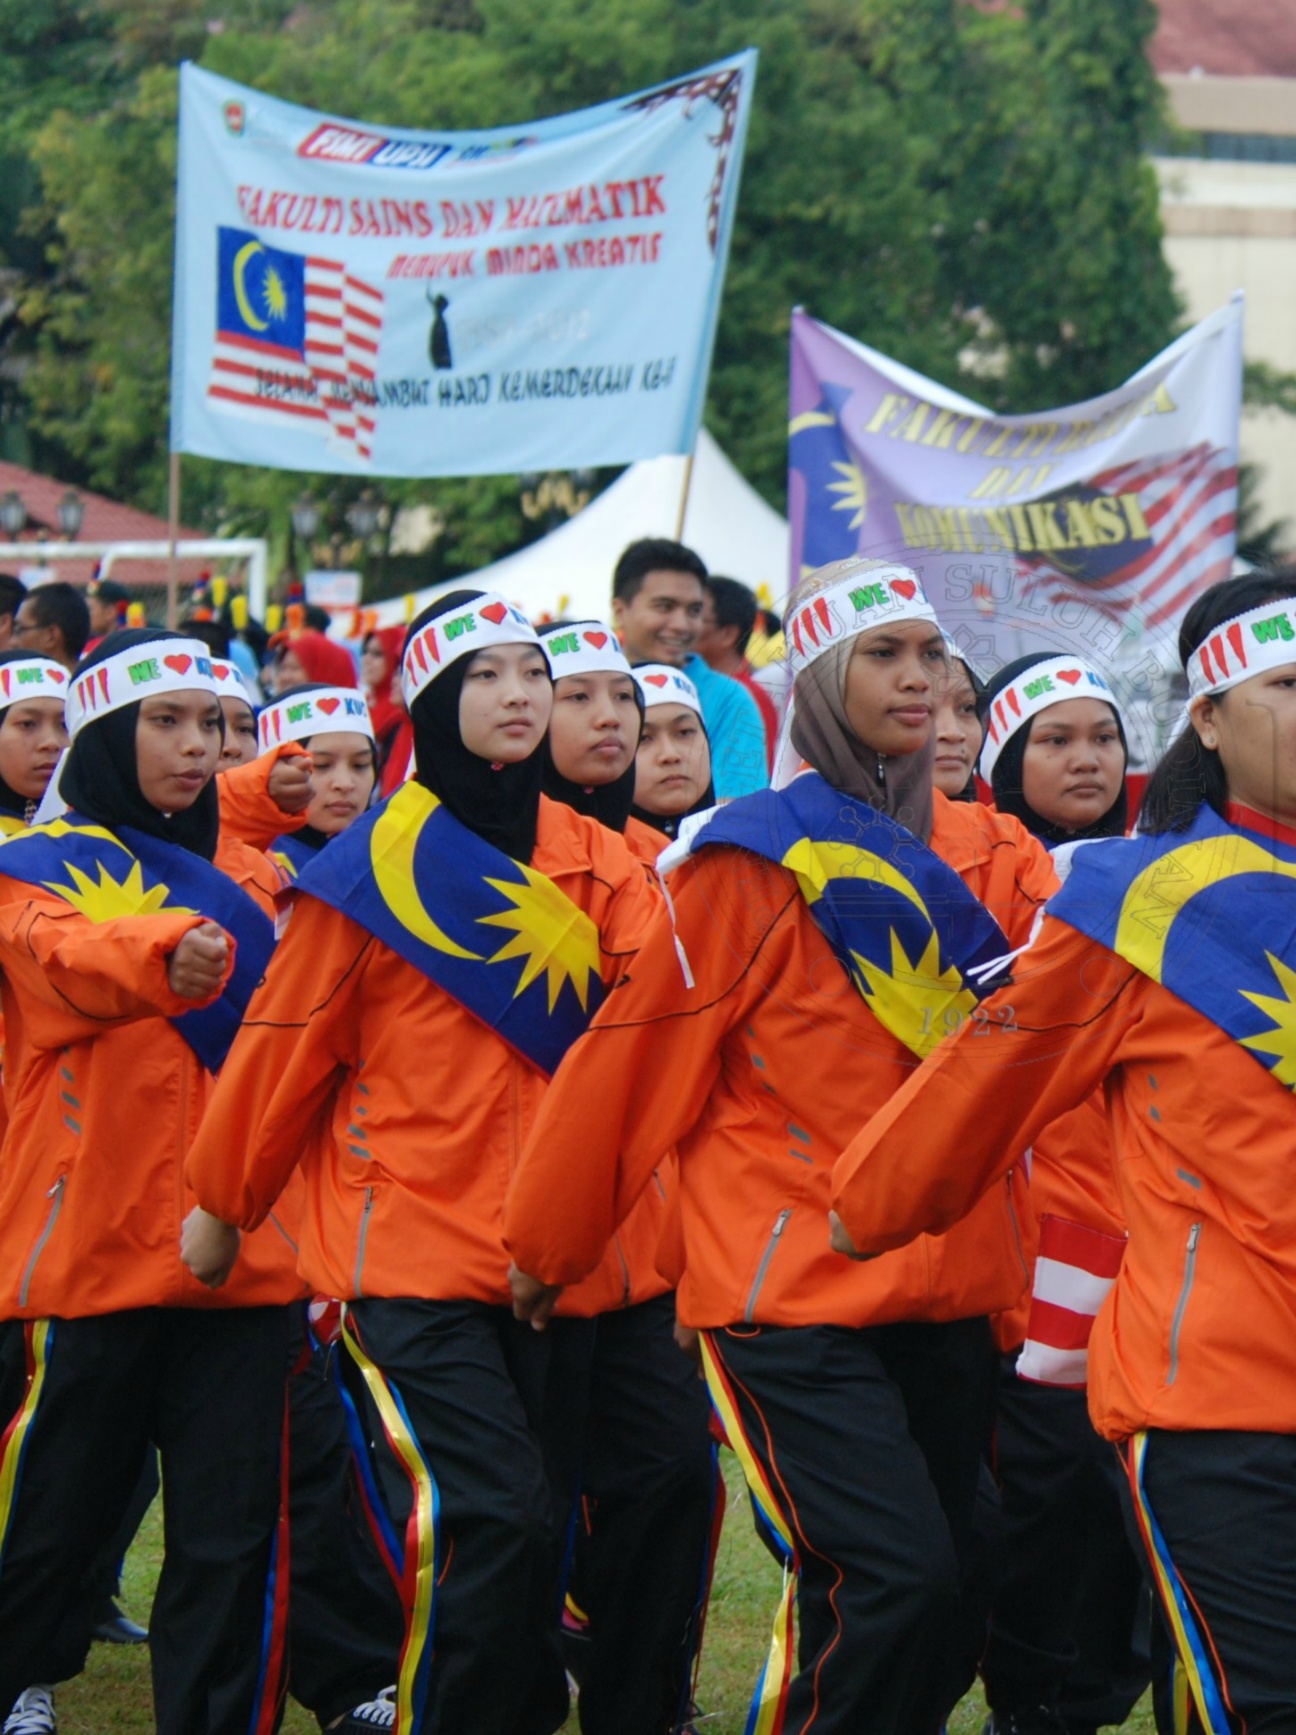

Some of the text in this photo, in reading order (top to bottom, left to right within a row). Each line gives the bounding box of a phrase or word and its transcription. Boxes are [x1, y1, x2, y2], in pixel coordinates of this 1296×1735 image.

[348, 196, 433, 238] SAINS
[440, 198, 495, 239] DAN
[848, 582, 891, 613] WE
[443, 612, 477, 641] WE
[1251, 611, 1295, 645] WE
[547, 631, 581, 657] WE
[17, 667, 44, 684] WE
[128, 659, 162, 686] WE
[1023, 675, 1056, 700] WE
[286, 701, 313, 724] WE
